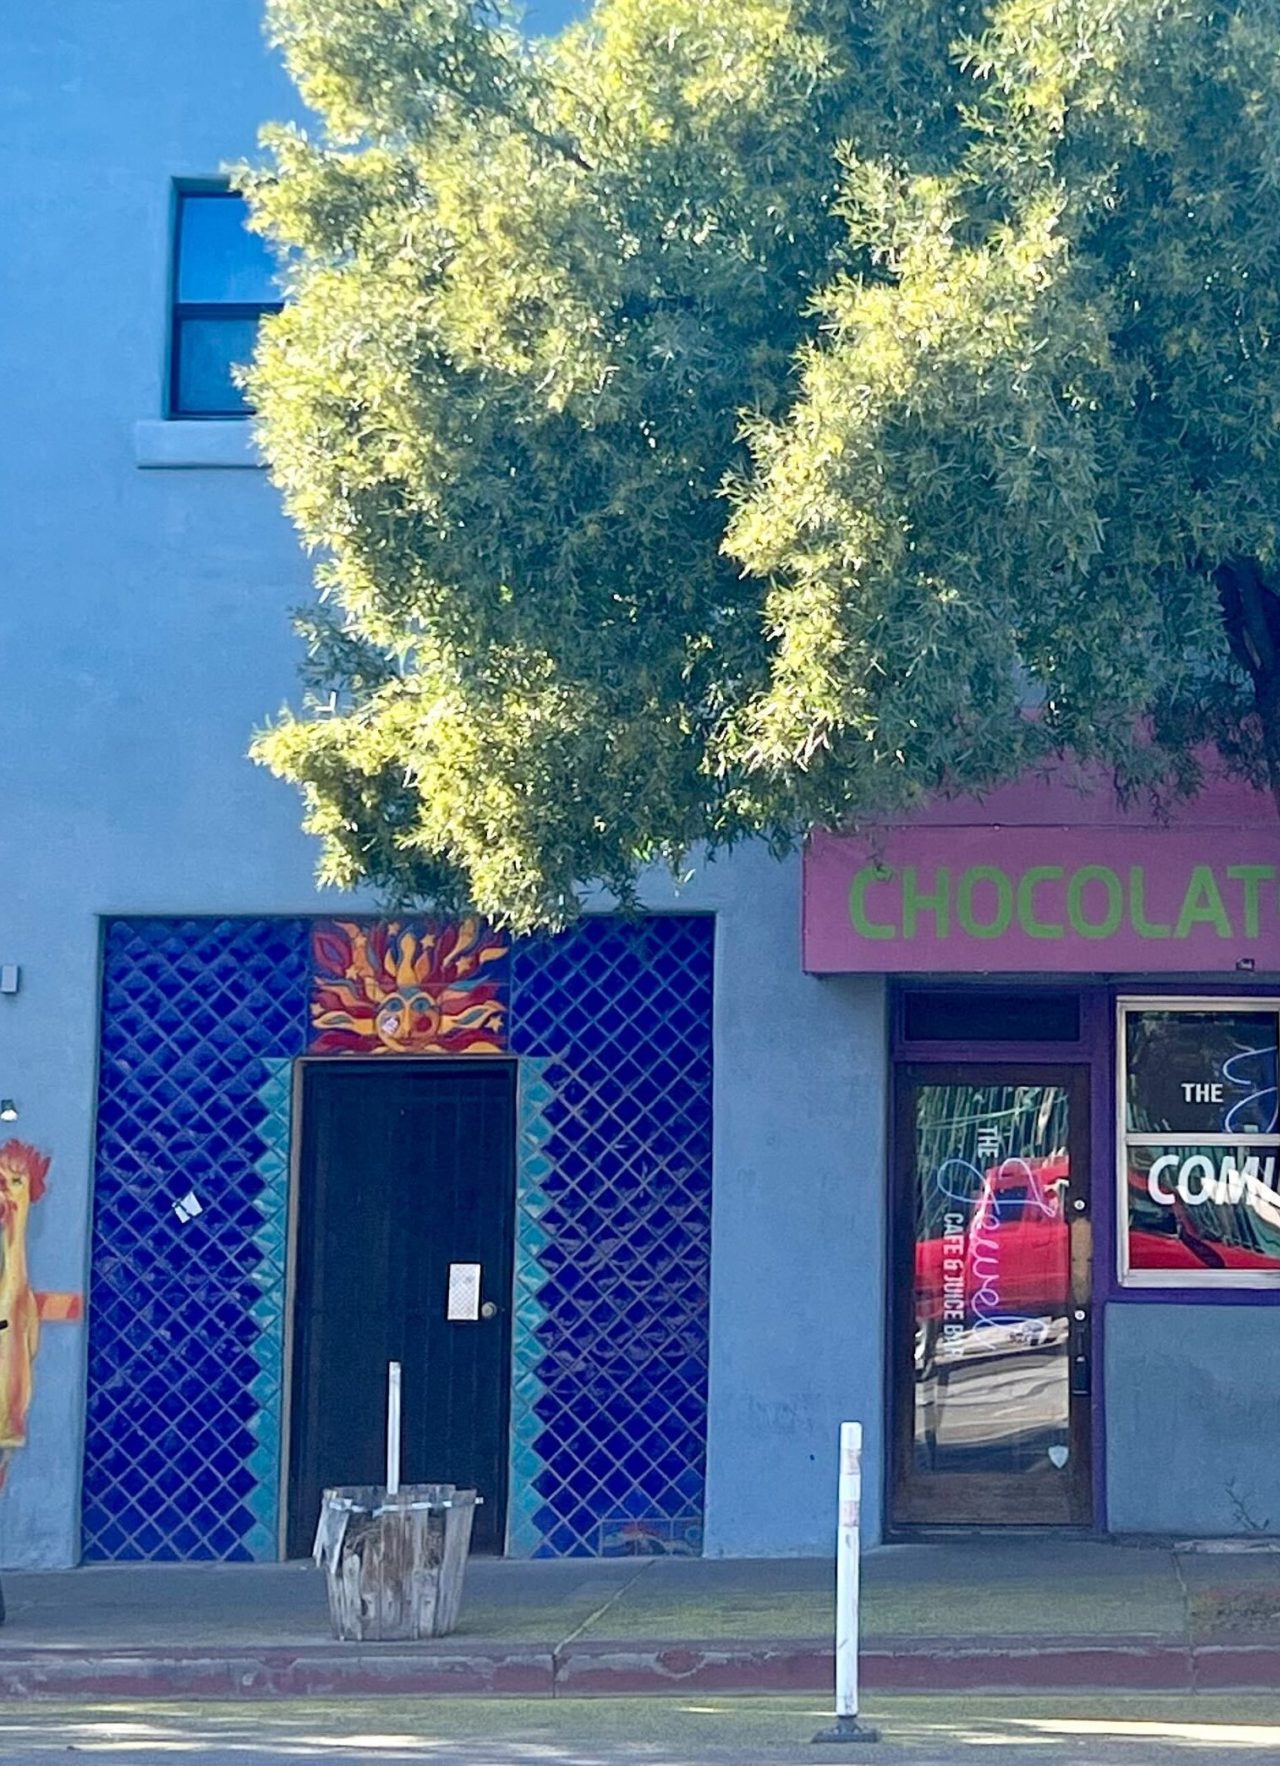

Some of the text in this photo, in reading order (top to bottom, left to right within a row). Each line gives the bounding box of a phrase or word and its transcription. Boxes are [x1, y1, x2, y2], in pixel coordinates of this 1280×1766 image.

[1181, 1083, 1224, 1103] THE
[977, 1126, 999, 1158] THE
[943, 1213, 964, 1255] CAFE
[943, 1258, 964, 1271] &
[943, 1274, 964, 1320] JUICE
